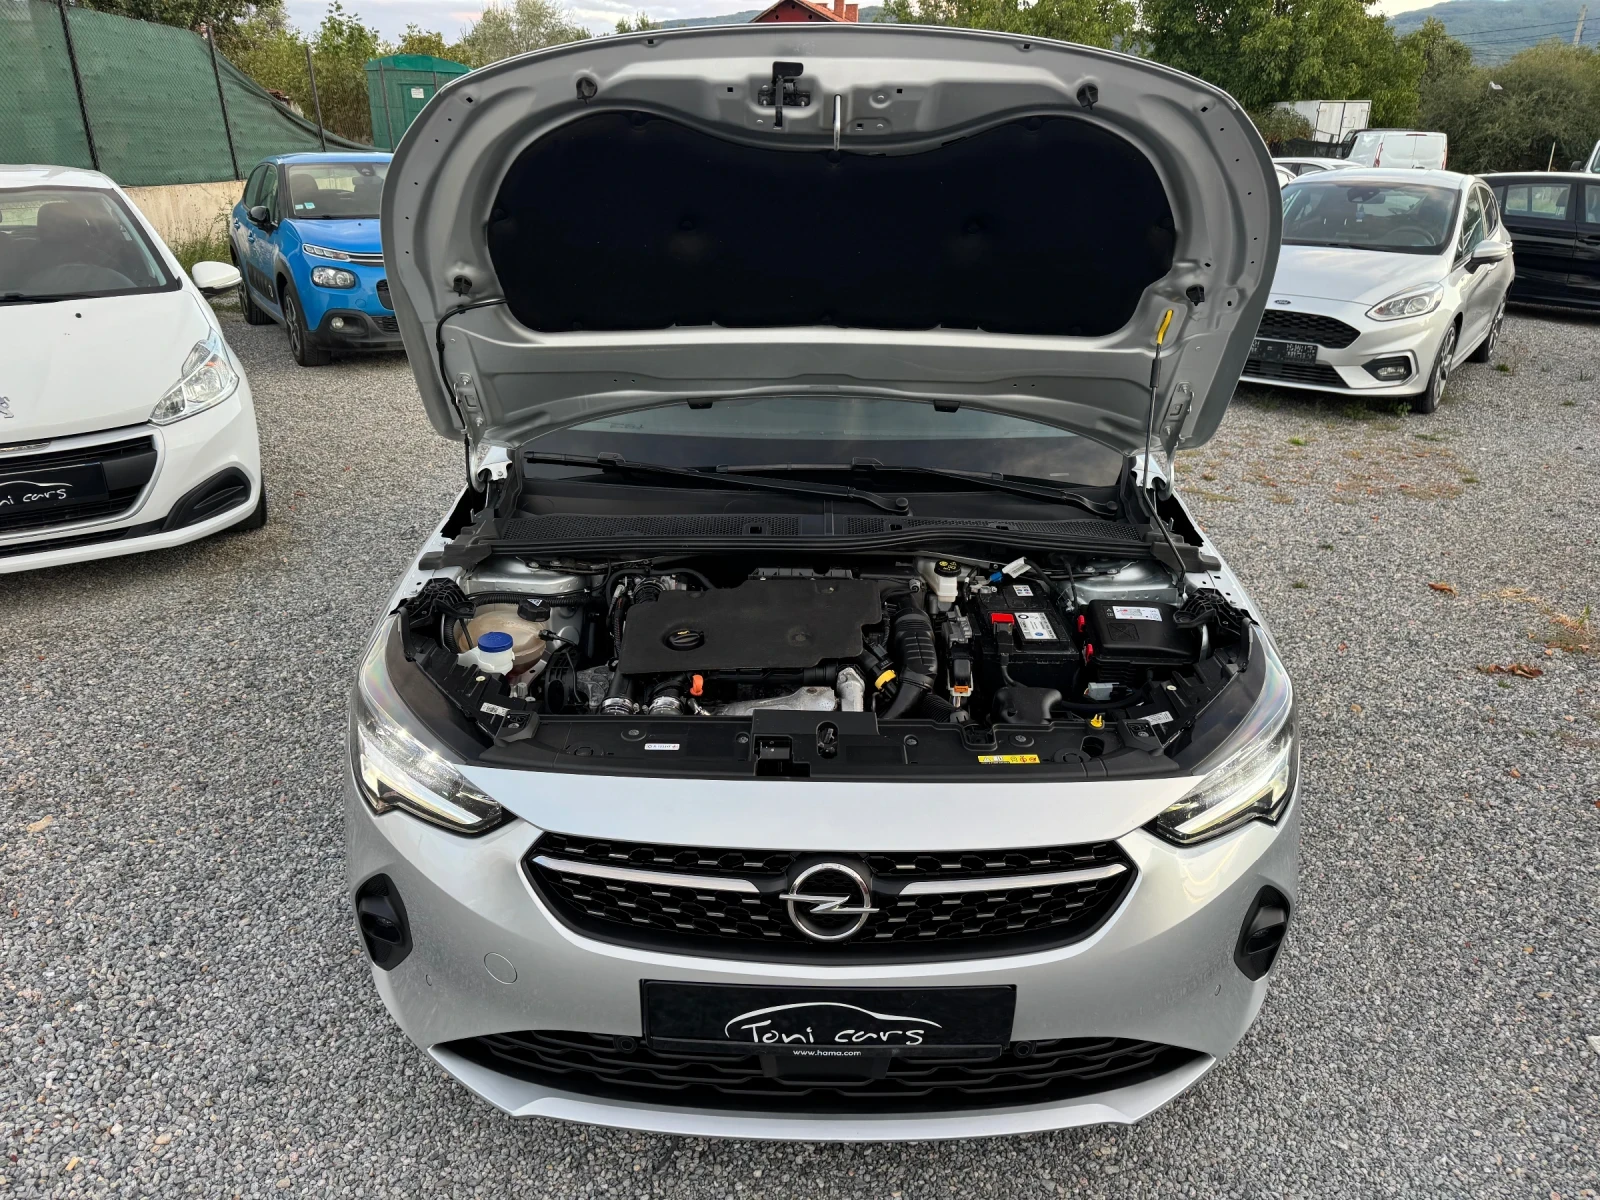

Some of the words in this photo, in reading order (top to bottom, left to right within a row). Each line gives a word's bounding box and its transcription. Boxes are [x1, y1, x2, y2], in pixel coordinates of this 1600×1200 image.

[22, 488, 67, 502] cars
[740, 1020, 815, 1044] Toni
[834, 1029, 925, 1046] cars
